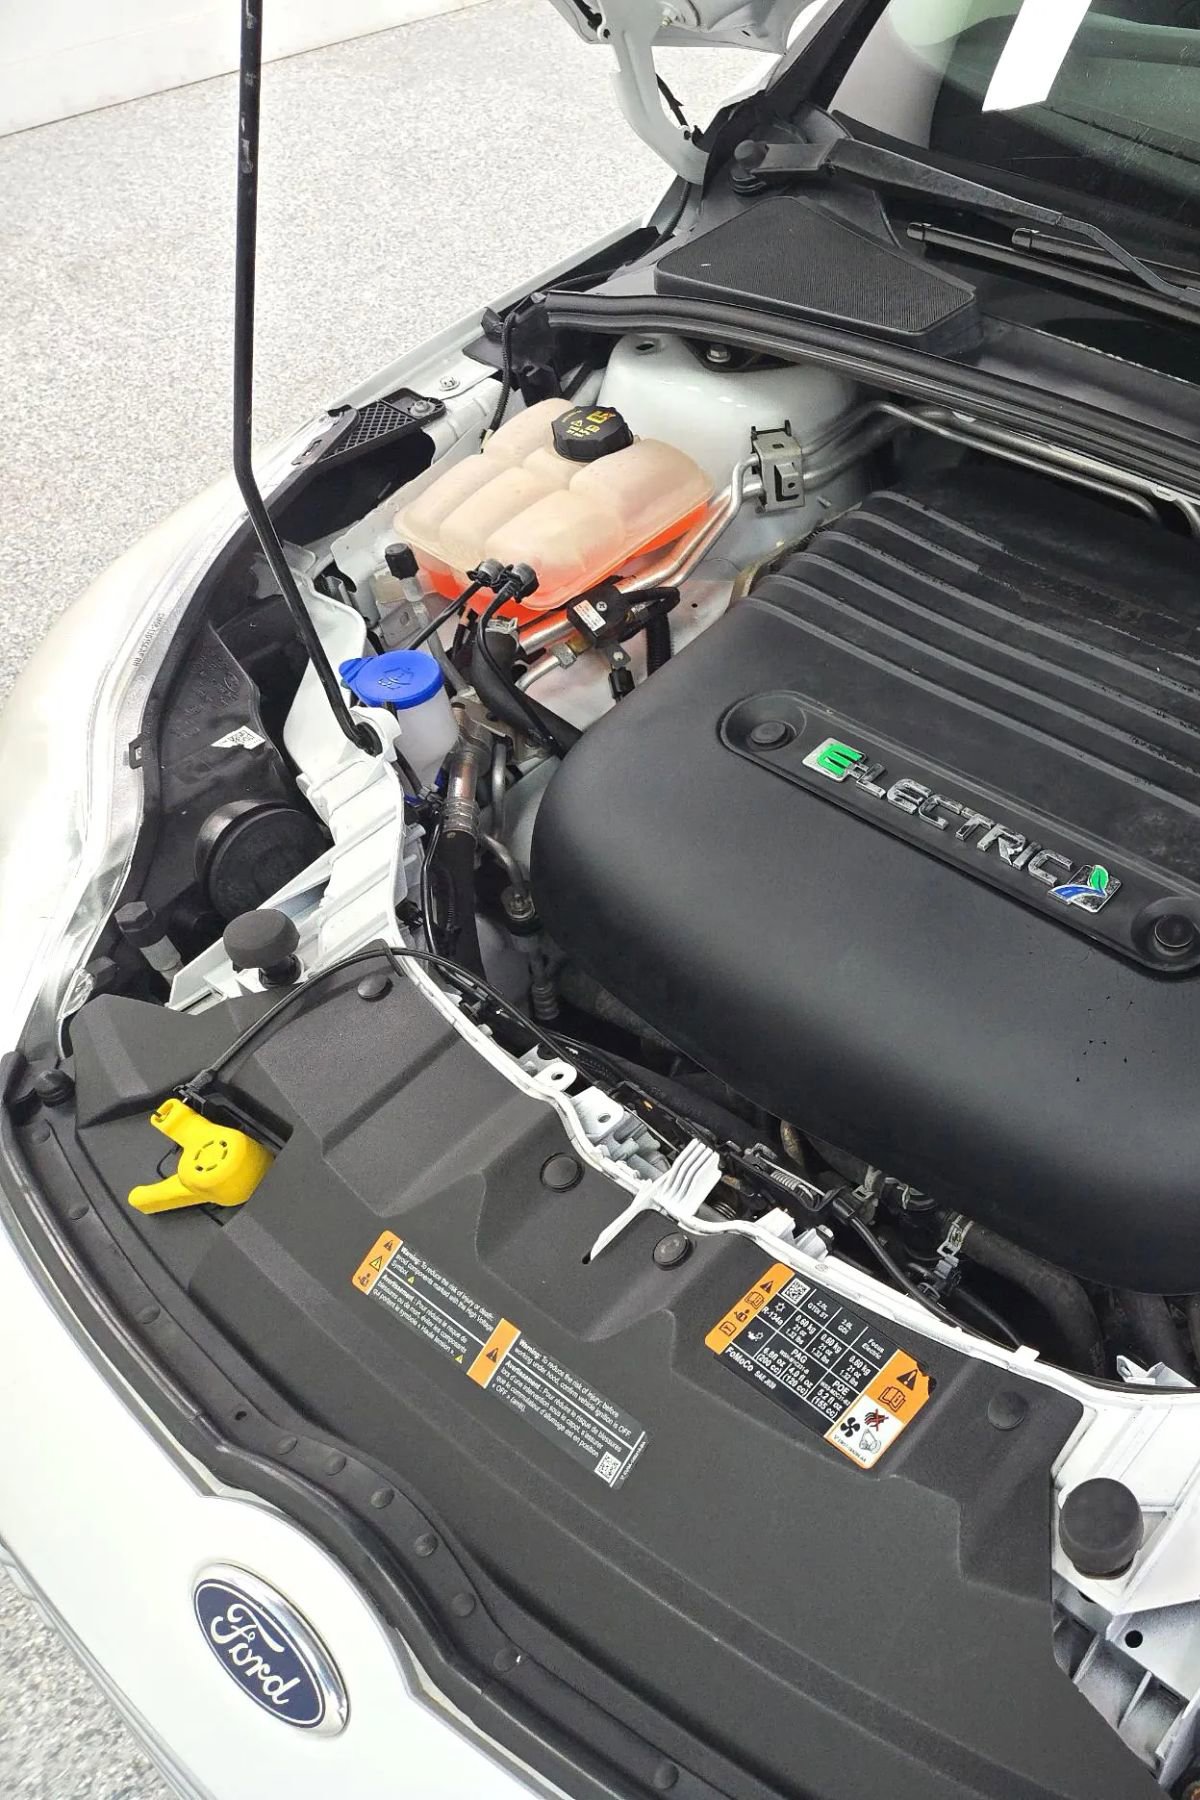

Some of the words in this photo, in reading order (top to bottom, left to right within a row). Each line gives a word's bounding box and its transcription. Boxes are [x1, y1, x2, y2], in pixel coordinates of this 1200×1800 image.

[806, 740, 1073, 887] ELECTRIC
[407, 1263, 434, 1285] components
[433, 1282, 450, 1298] marked
[449, 1295, 459, 1305] with
[425, 1266, 442, 1281] reduce
[441, 1278, 449, 1286] the
[448, 1284, 458, 1293] risk
[461, 1293, 474, 1307] injury
[415, 1300, 428, 1312] Pour
[761, 1306, 783, 1326] R-134a
[792, 1324, 801, 1332] 21
[795, 1314, 809, 1327] 0.60
[807, 1323, 816, 1335] kg
[440, 1331, 467, 1354] composants
[785, 1328, 797, 1339] 1.32
[795, 1335, 804, 1345] lbs
[818, 1343, 827, 1351] 21
[820, 1333, 835, 1346] 0.60
[832, 1342, 842, 1354] kg
[868, 1338, 884, 1353] Focus
[790, 1348, 808, 1364] PAG
[811, 1347, 823, 1359] 1.32
[820, 1354, 830, 1364] lbs
[861, 1343, 882, 1360] Electric
[725, 1346, 754, 1371] FoMoCo
[754, 1370, 767, 1381] SAE
[756, 1352, 771, 1368] (200
[767, 1364, 782, 1376] cc)
[776, 1358, 786, 1367] oz
[846, 1365, 855, 1373] 21
[853, 1371, 861, 1379] oz
[849, 1355, 864, 1368] 0.60
[861, 1364, 871, 1376] kg
[519, 1339, 542, 1359] Warning:
[547, 1362, 565, 1377] reduce
[564, 1373, 573, 1383] the
[572, 1380, 582, 1391] risk
[602, 1402, 619, 1418] before
[781, 1373, 798, 1387] (120
[796, 1385, 809, 1397] cc)
[788, 1367, 800, 1377] 4.0
[803, 1379, 813, 1389] oz
[832, 1380, 850, 1396] POE
[849, 1377, 858, 1387] lbs
[496, 1385, 508, 1396] OFF
[522, 1384, 550, 1408] intervention
[549, 1406, 561, 1417] sous
[532, 1361, 547, 1374] under
[560, 1382, 578, 1398] confirm
[578, 1395, 595, 1411] vehicle
[594, 1407, 613, 1425] ignition
[817, 1389, 830, 1400] 5.2
[833, 1402, 843, 1411] oz
[809, 1396, 828, 1410] (155
[823, 1408, 838, 1421] cc)
[542, 1388, 555, 1400] Pour
[575, 1415, 591, 1429] risque
[598, 1430, 622, 1452] blessures
[578, 1440, 599, 1458] position
[210, 1603, 301, 1705] Ford
